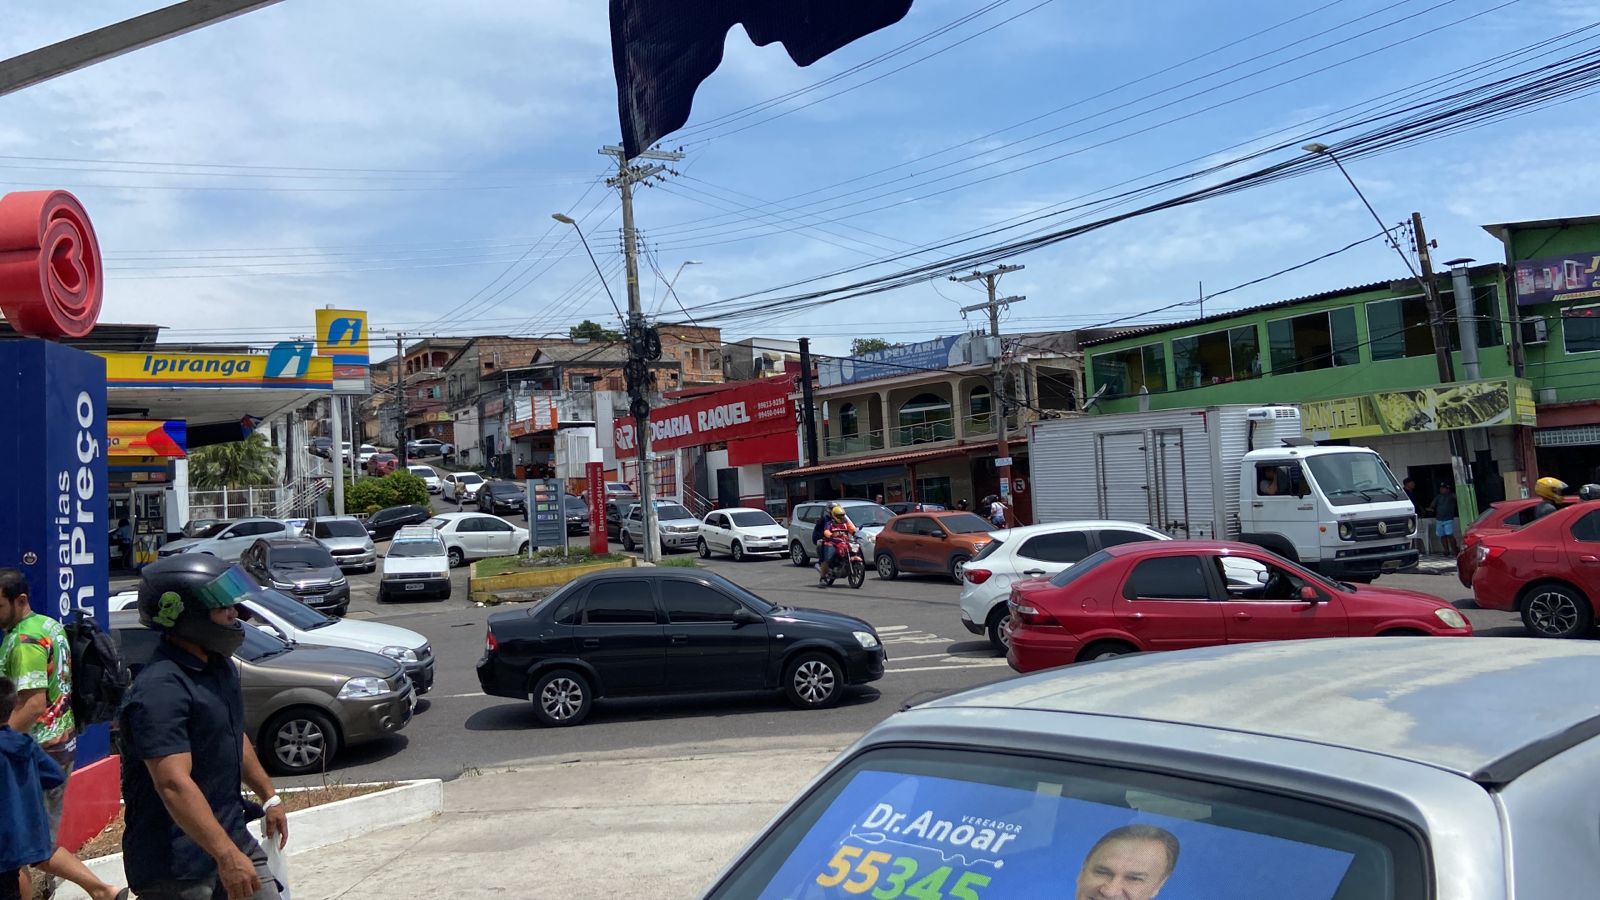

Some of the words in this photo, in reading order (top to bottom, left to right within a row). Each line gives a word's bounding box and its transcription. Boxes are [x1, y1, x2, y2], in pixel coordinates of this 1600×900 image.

[143, 355, 251, 376] Ipiranga
[884, 339, 945, 359] PEIXARIA
[634, 414, 693, 446] OGARIA
[698, 401, 751, 432] RAQUEL
[72, 390, 99, 565] Preço
[596, 466, 605, 532] Banco24Horas
[55, 470, 74, 624] ogarias
[961, 815, 1023, 833] VEREADOR
[815, 845, 992, 900] 55345
